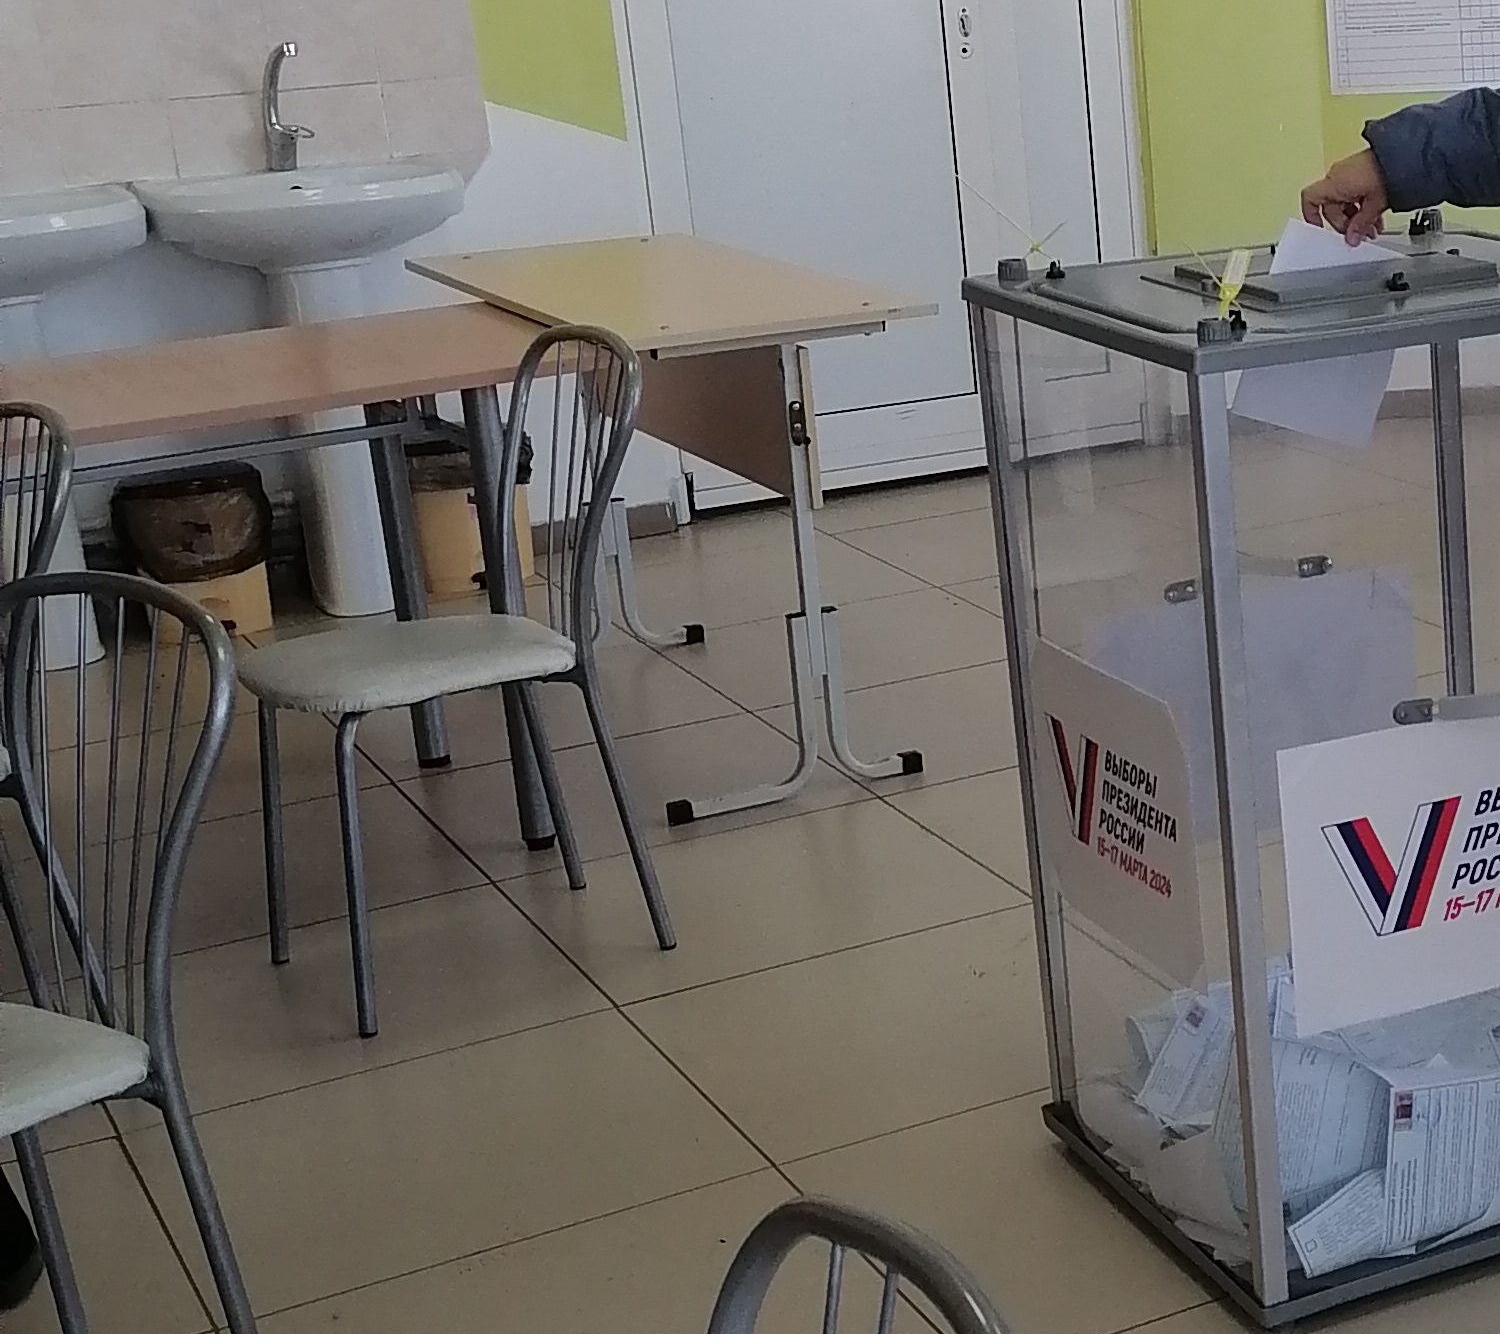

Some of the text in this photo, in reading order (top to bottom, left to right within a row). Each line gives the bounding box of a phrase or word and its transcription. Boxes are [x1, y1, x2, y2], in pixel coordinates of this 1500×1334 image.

[1104, 749, 1158, 799] ВЫБОРЫ
[1099, 808, 1145, 854] РОССИИ
[1102, 779, 1177, 843] ПРЕЗИДЕНТА
[1119, 851, 1148, 885] МАРТА
[1149, 869, 1172, 899] 2024
